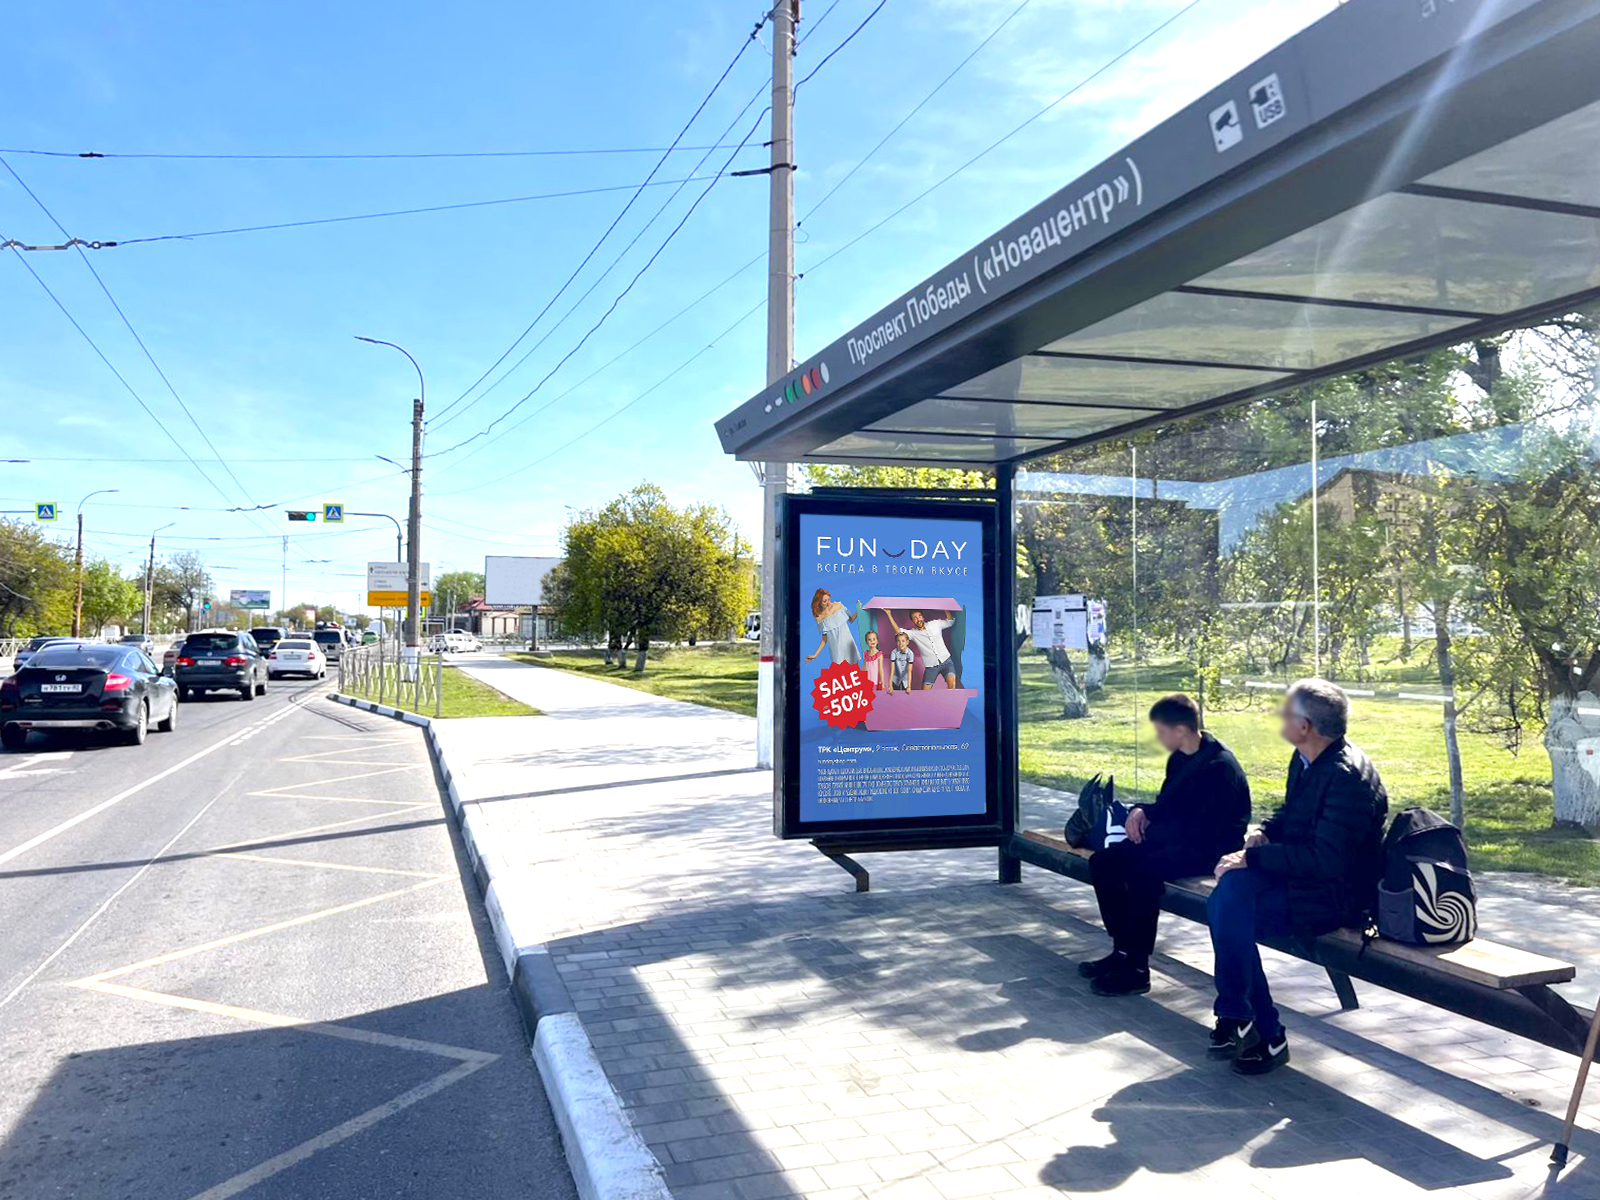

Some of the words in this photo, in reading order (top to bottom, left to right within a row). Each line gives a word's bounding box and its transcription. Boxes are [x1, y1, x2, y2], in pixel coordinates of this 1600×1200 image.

[1258, 99, 1283, 123] USB
[847, 311, 907, 366] Проспект
[906, 271, 971, 329] Победы
[974, 156, 1143, 294] («Новацентр»)
[816, 536, 877, 557] FUN
[910, 539, 968, 560] DAY
[816, 563, 865, 574] ВСЕГДА
[871, 564, 879, 574] В
[885, 565, 925, 575] ТВОЕМ
[931, 566, 968, 577] ВКУСЕ
[819, 670, 861, 699] SALE
[822, 690, 868, 717] -50%
[818, 745, 831, 753] ТРК
[876, 744, 881, 752] 2
[961, 742, 970, 750] 62
